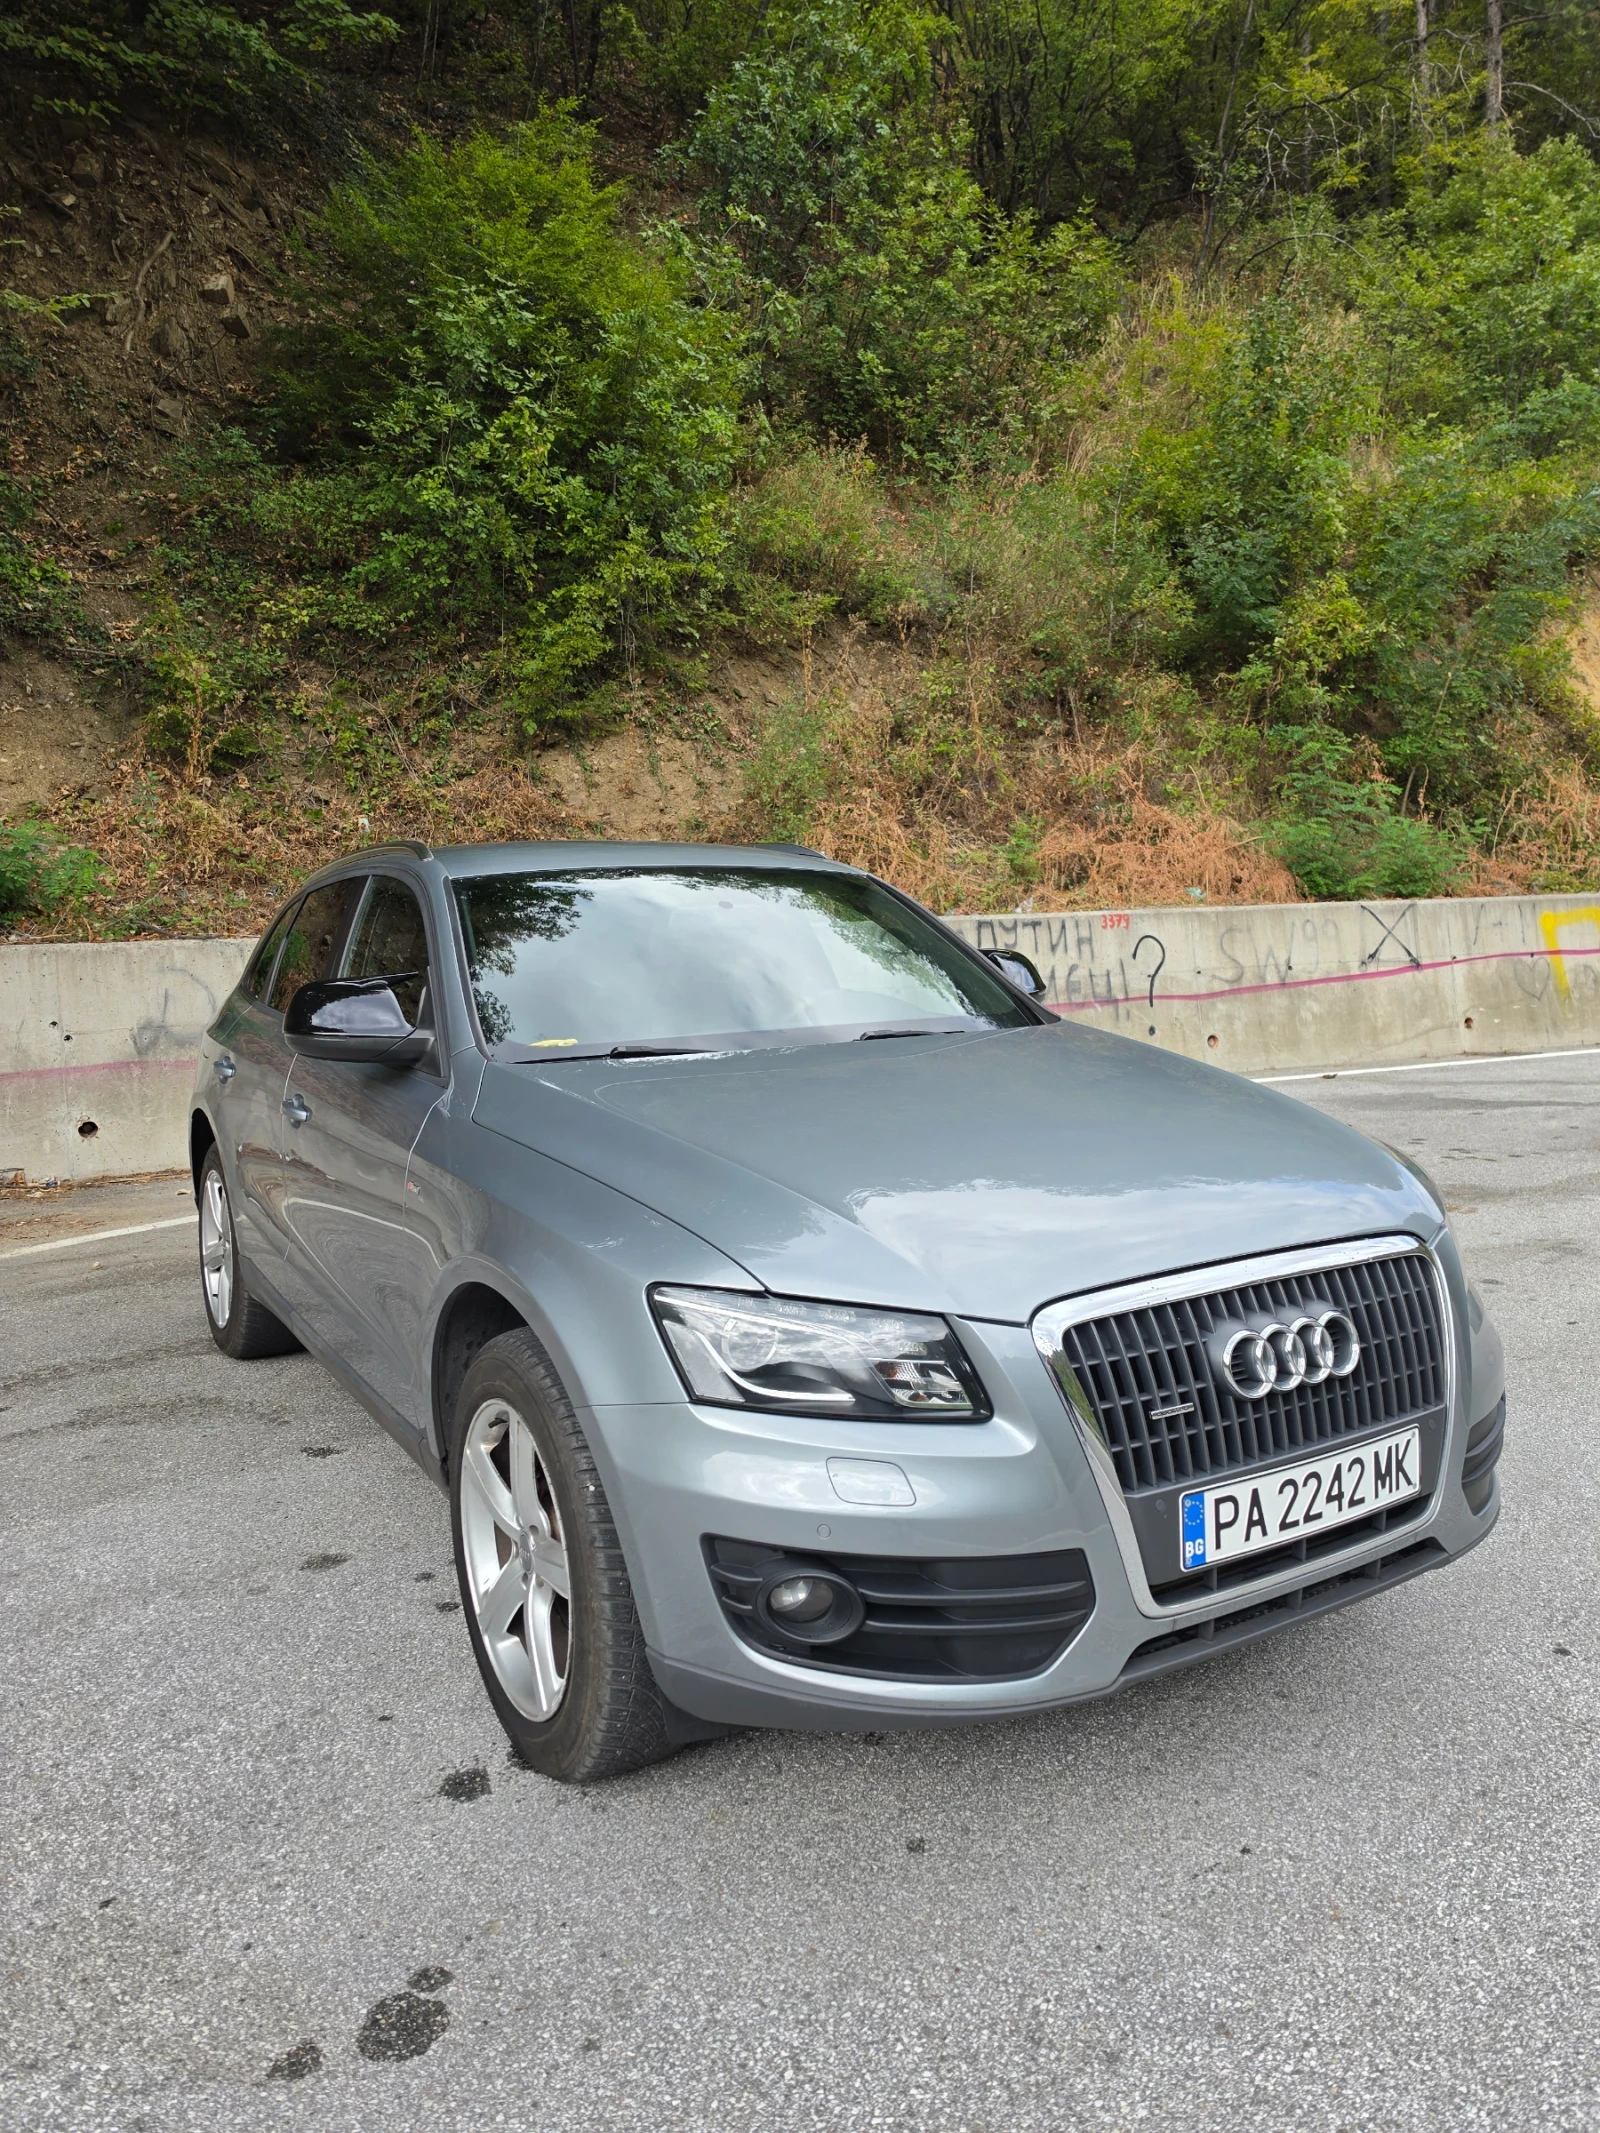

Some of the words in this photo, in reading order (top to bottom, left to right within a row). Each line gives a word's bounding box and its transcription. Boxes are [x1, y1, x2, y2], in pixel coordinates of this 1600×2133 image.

[1101, 913, 1131, 931] 3379
[976, 918, 1095, 962] ПУТИН
[1213, 1486, 1268, 1550] PA
[1278, 1457, 1365, 1531] 2242
[1373, 1437, 1414, 1500] MK
[1184, 1538, 1205, 1558] BG
